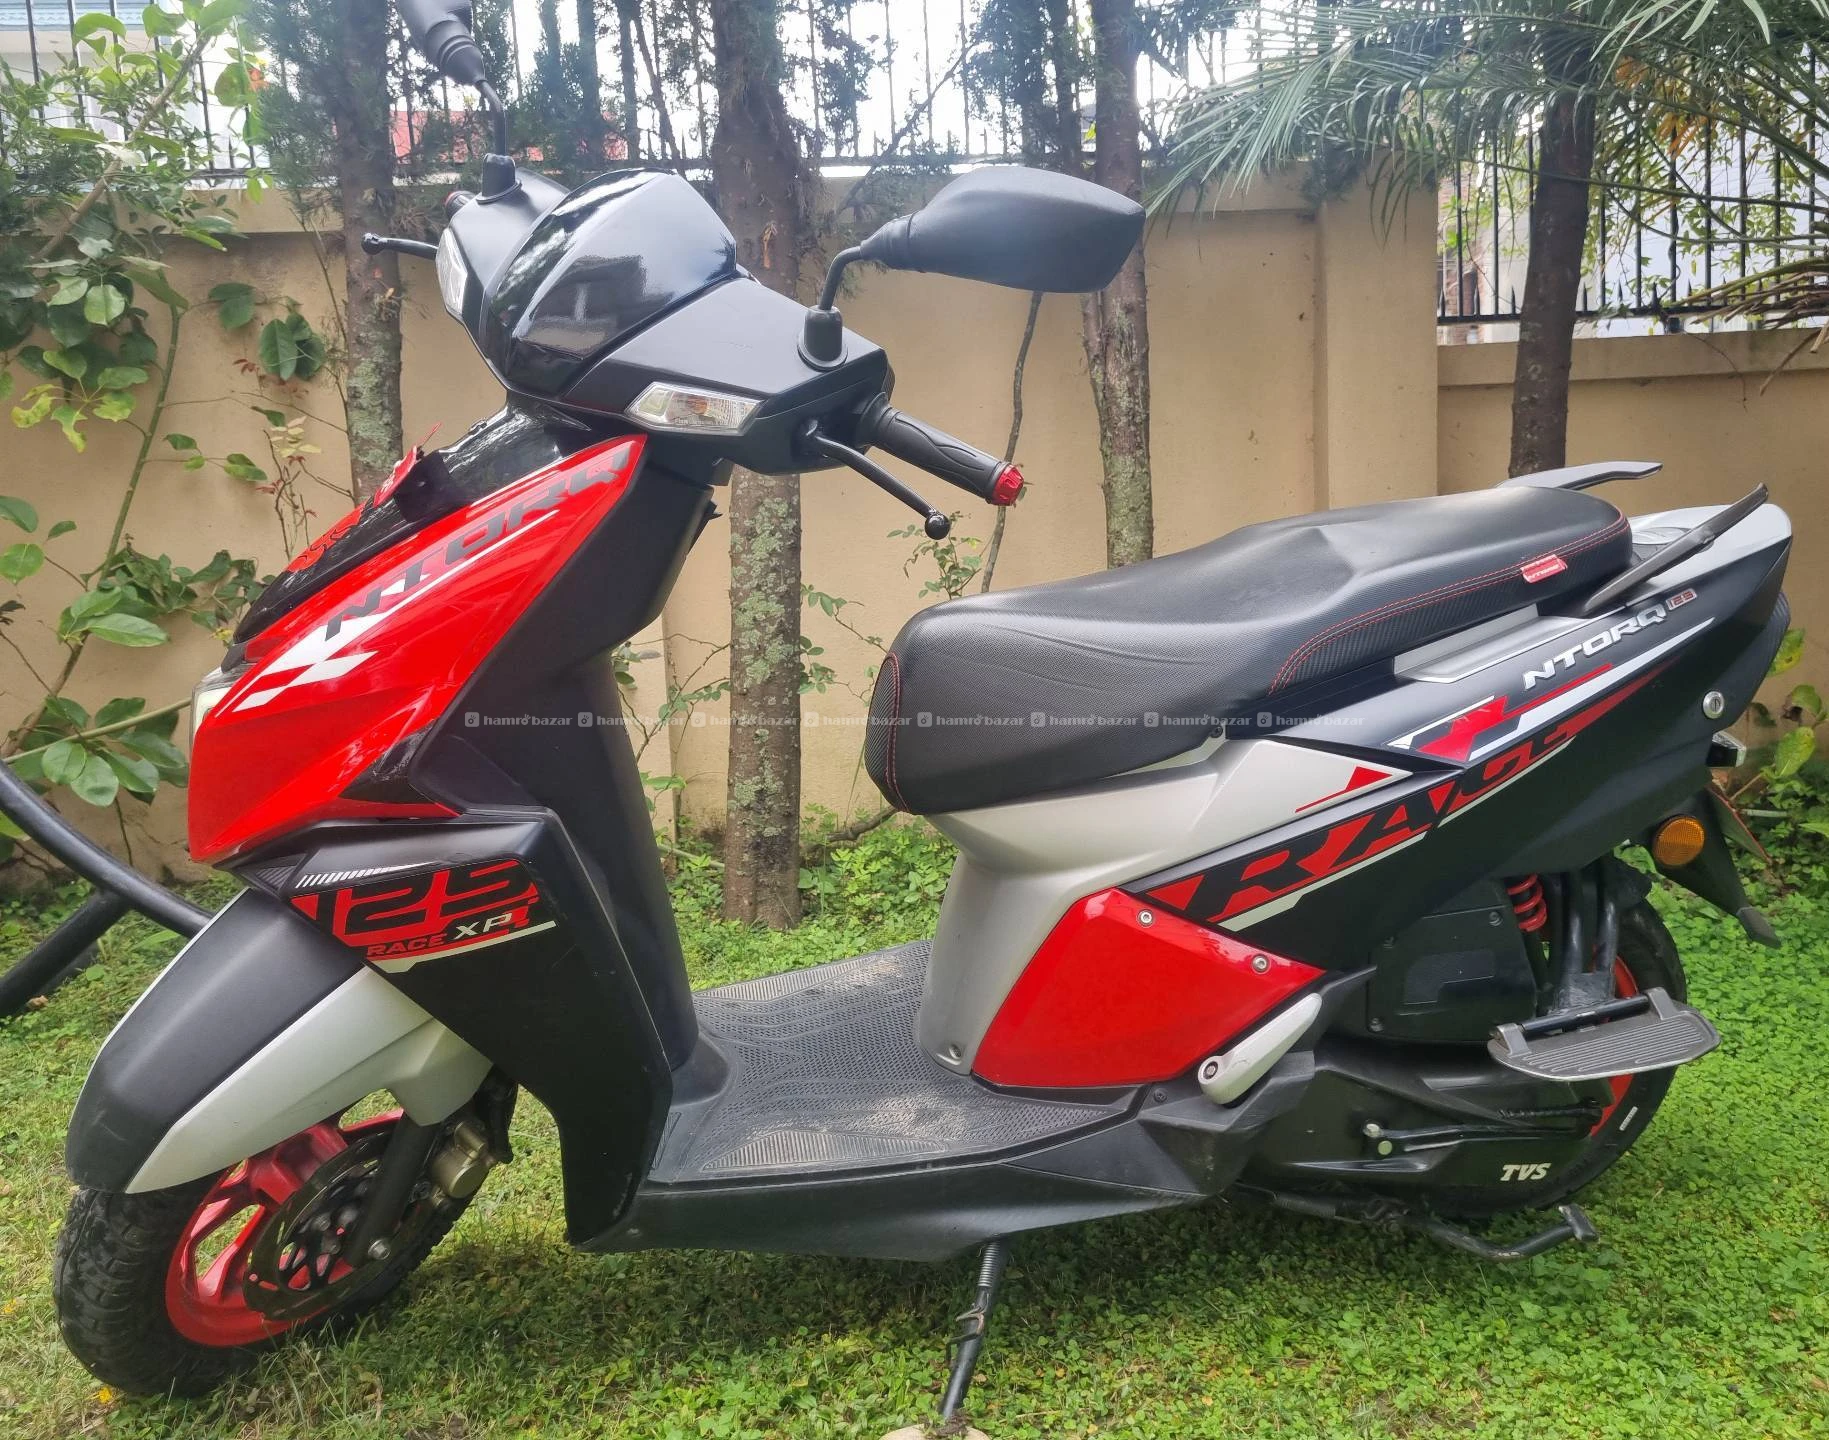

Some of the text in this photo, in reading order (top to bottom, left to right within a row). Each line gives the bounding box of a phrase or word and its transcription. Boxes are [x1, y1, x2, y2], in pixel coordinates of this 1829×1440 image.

[1522, 603, 1668, 691] NTORQ
[314, 860, 537, 937] 125
[366, 912, 513, 956] RACE XP
[1500, 1162, 1552, 1182] TVS
